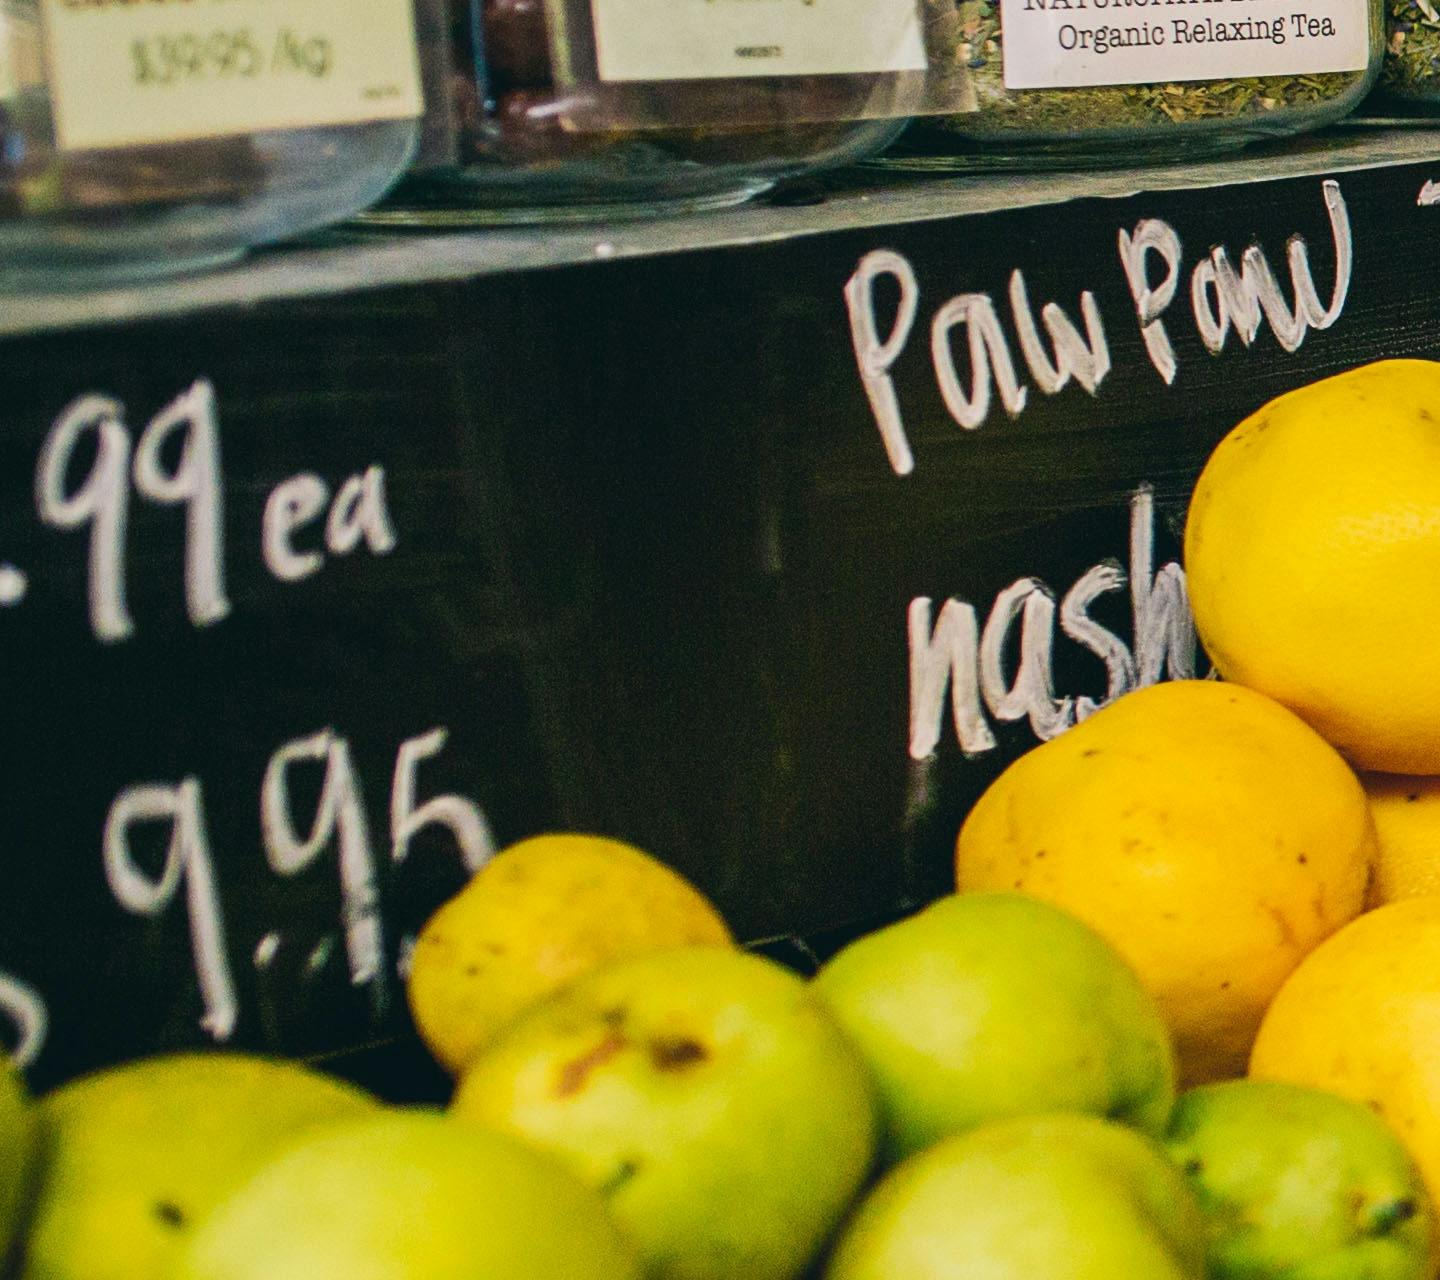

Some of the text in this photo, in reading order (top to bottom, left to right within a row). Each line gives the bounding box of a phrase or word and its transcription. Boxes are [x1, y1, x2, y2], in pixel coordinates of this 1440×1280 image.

[1058, 13, 1336, 55] Organic Relaxing Tea
[262, 460, 397, 581] ea
